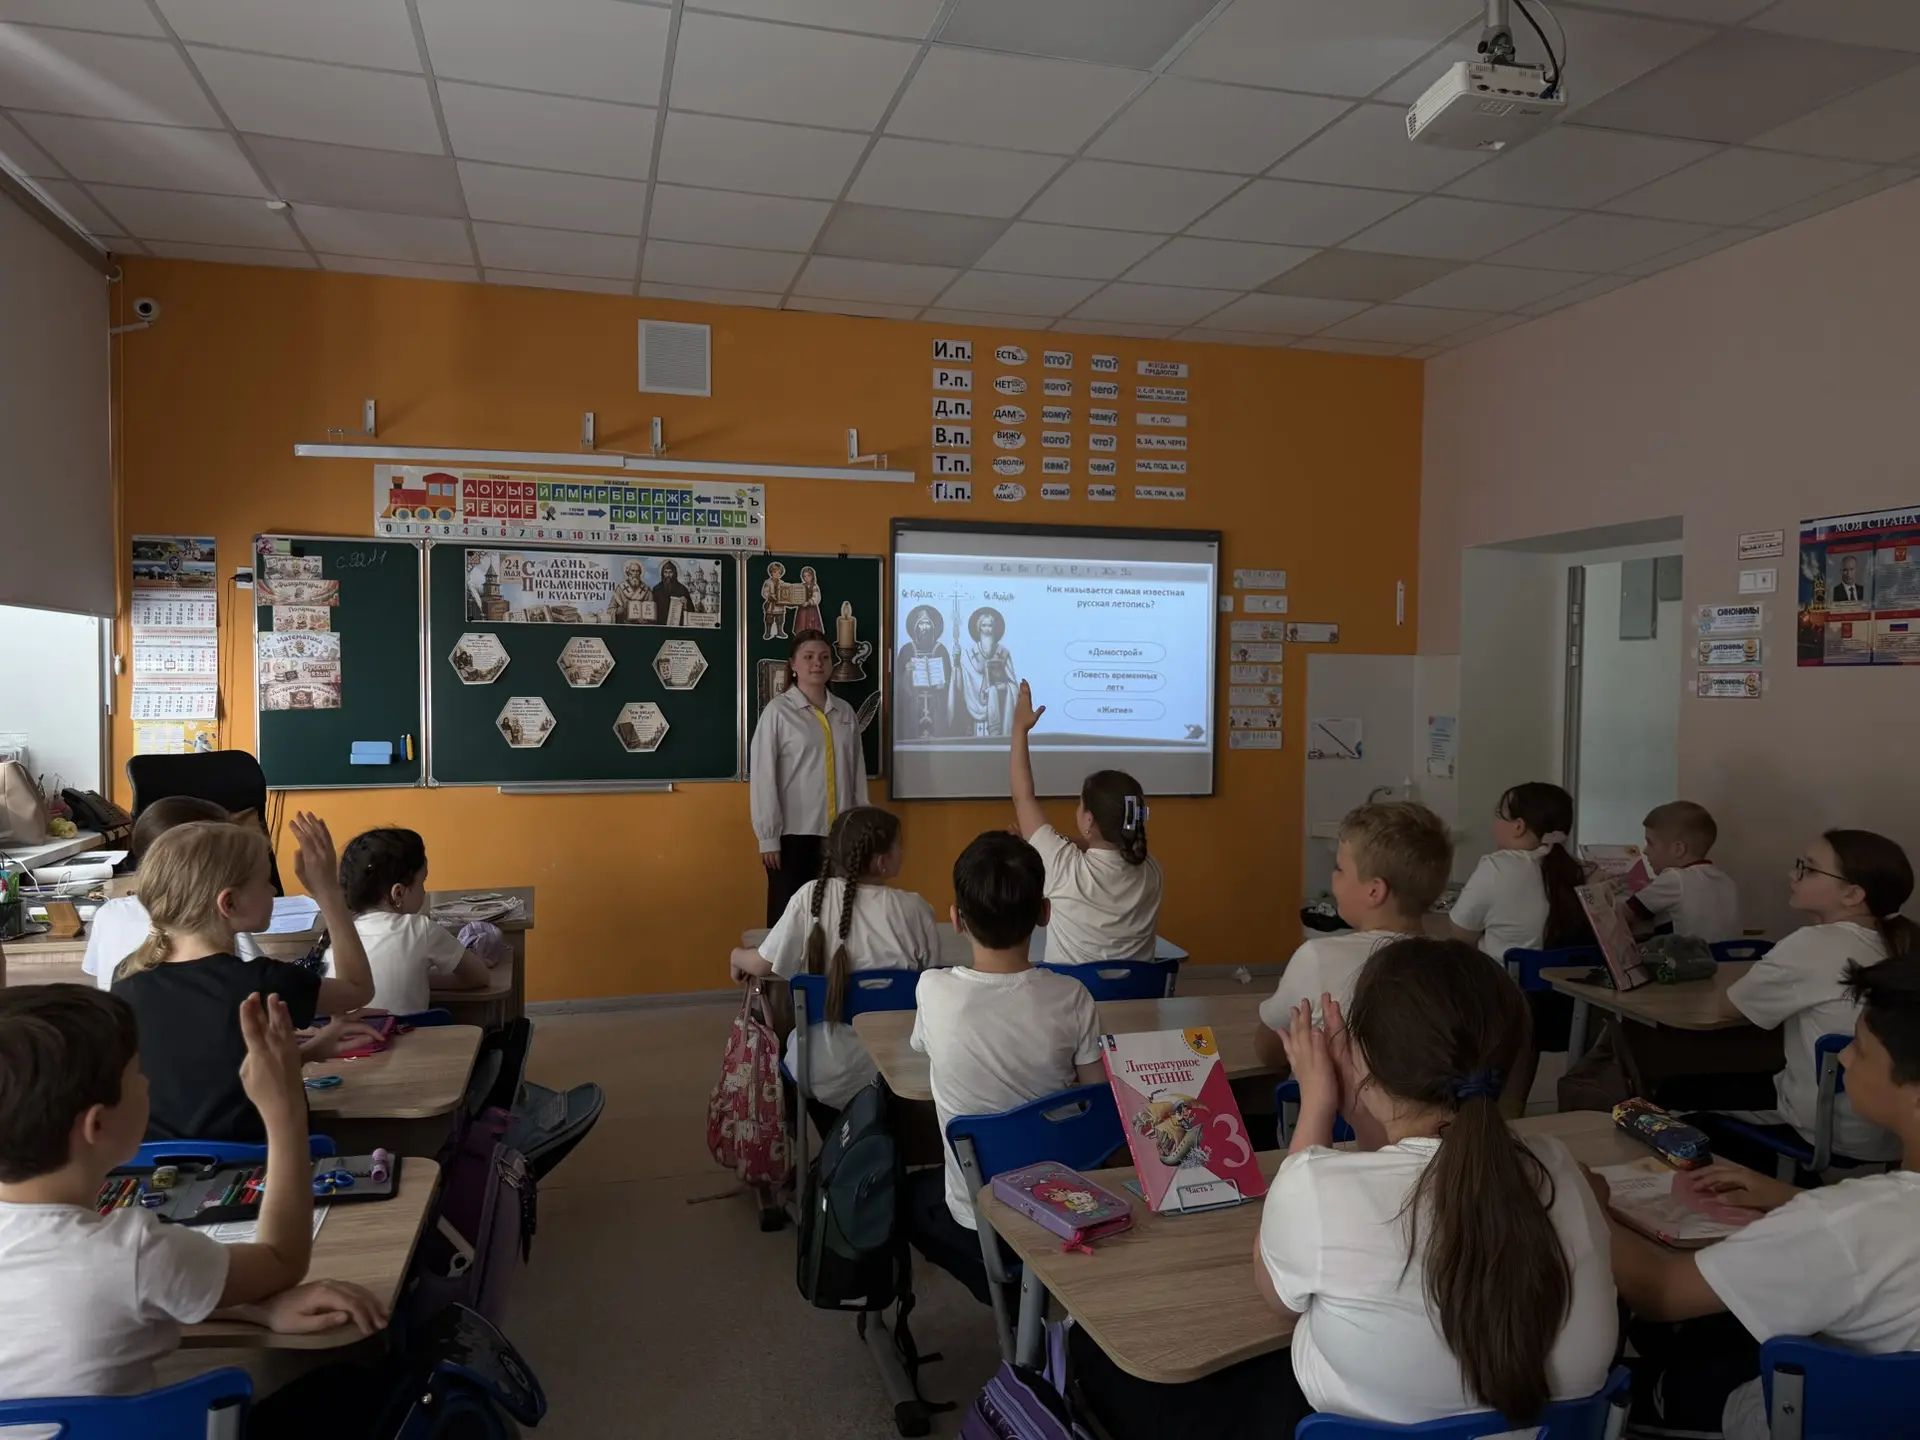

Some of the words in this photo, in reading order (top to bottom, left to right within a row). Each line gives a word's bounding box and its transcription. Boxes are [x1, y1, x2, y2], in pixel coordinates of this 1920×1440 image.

[935, 342, 971, 359] И.п.
[940, 372, 968, 387] Р.п.
[935, 400, 970, 416] Д.п.
[936, 428, 970, 444] В.п.
[997, 432, 1022, 440] ВИЖУ
[936, 456, 970, 472] Т.п.
[465, 484, 475, 494] А
[480, 485, 490, 494] О
[495, 485, 504, 495] У
[509, 486, 520, 495] Ы
[525, 487, 534, 496] Э
[540, 486, 548, 496] Й
[554, 489, 564, 497] Л
[569, 490, 579, 498] М
[584, 490, 592, 498] Н
[599, 491, 606, 499] Р
[613, 492, 621, 500] Б
[627, 492, 635, 500] В
[641, 492, 648, 501] Г
[654, 493, 663, 503] Д
[667, 494, 679, 503] Ж
[683, 494, 691, 503] З
[465, 503, 475, 512] Я
[481, 501, 490, 513] Ё
[493, 503, 507, 513] Ю
[510, 504, 520, 513] И
[525, 505, 534, 514] Е
[613, 510, 621, 518] П
[625, 510, 637, 519] Ф
[641, 510, 649, 519] К
[655, 511, 663, 519] Т
[667, 511, 679, 520] Ш
[682, 511, 691, 521] С
[696, 512, 705, 522] Х
[709, 512, 718, 523] Ц
[723, 513, 732, 522] Ч
[735, 514, 747, 524] Щ
[1836, 522, 1862, 533] МОЯ
[1868, 515, 1917, 528] СТРАНА
[386, 524, 392, 532] 0
[406, 525, 410, 533] 1
[424, 525, 430, 533] 2
[443, 526, 450, 534] 3
[462, 527, 469, 535] 4
[481, 527, 488, 535] 5
[500, 528, 506, 536] 6
[520, 529, 525, 537] 7
[538, 530, 544, 538] 8
[556, 531, 562, 539] 9
[573, 531, 584, 539] 10
[591, 532, 600, 540] 11
[609, 532, 619, 540] 12
[627, 533, 638, 541] 13
[645, 534, 655, 542] 14
[663, 534, 673, 542] 15
[680, 535, 690, 543] 16
[698, 536, 707, 544] 17
[715, 536, 725, 544] 18
[732, 537, 742, 545] 19
[748, 538, 758, 546] 20
[504, 560, 519, 570] 24
[551, 560, 586, 570] ДЕНЬ
[548, 592, 606, 602] КУЛЬТУРЫ
[1064, 587, 1113, 595] называется
[1077, 600, 1110, 608] русская
[1111, 600, 1155, 609] летопись?
[1088, 648, 1143, 658] «Домострой»
[303, 662, 337, 673] Русский
[1073, 672, 1110, 680] «Повесть
[1112, 672, 1158, 681] временных
[1097, 706, 1133, 715] «Житие»
[1125, 1058, 1200, 1074] Литературное
[1140, 1070, 1194, 1086] ЧТЕНИЕ
[1212, 1113, 1250, 1168] 3
[1186, 1186, 1208, 1194] Часть
[1209, 1184, 1214, 1192] 2
